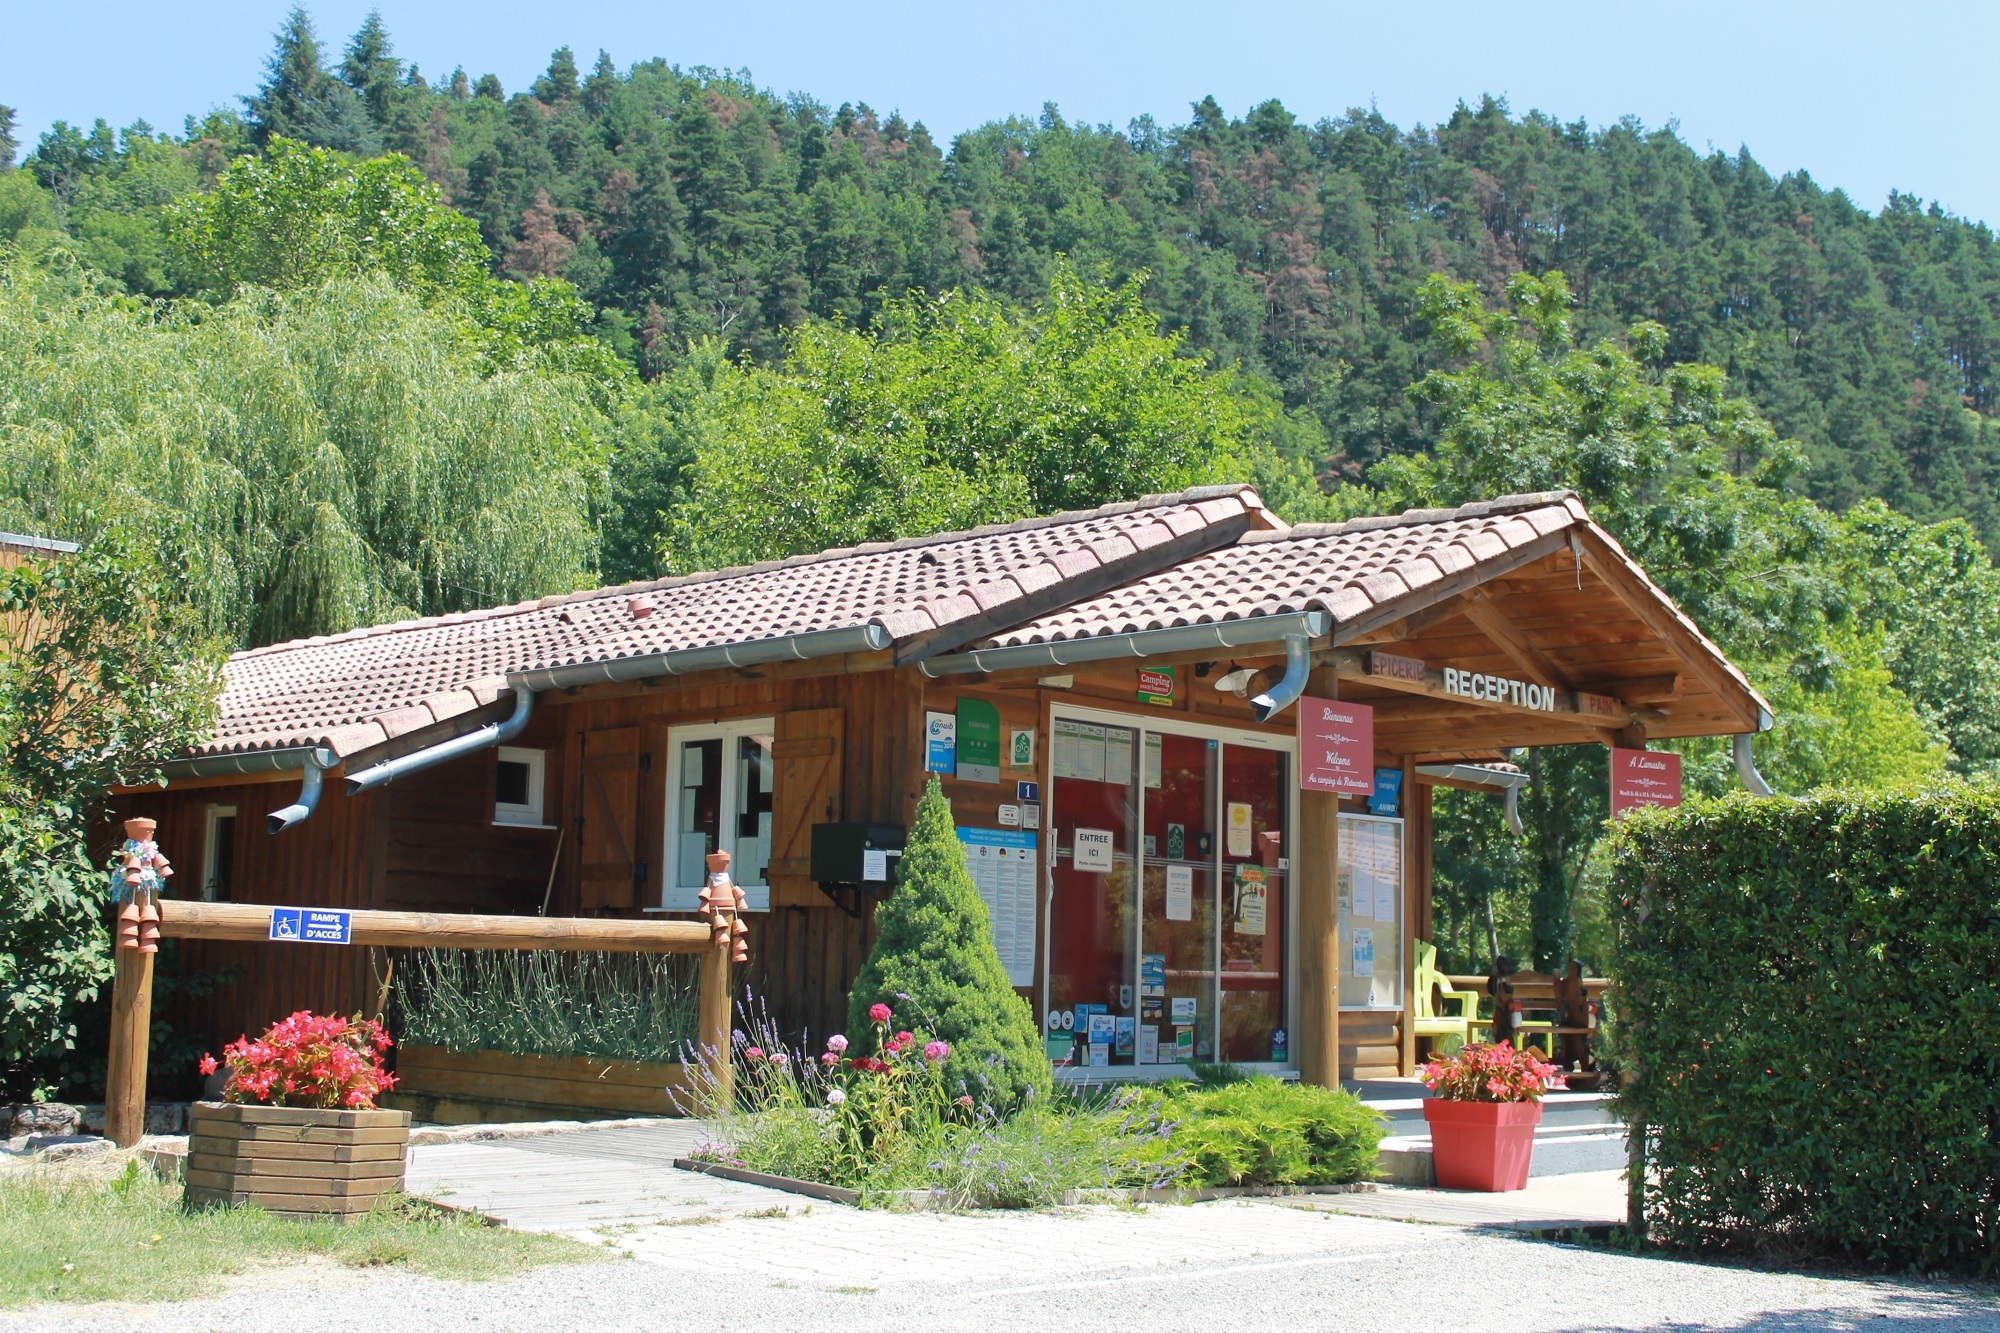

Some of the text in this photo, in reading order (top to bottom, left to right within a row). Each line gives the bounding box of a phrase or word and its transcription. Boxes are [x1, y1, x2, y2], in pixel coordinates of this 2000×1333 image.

[1373, 655, 1425, 681] EPICERIE
[1141, 673, 1170, 687] Camping
[1444, 668, 1555, 711] RECEPTION
[1590, 696, 1613, 716] PAIN
[1323, 707, 1354, 723] Bienvenue
[935, 722, 954, 730] anwb
[1325, 750, 1351, 766] Welcome
[1629, 757, 1666, 770] A Lamastre
[1308, 773, 1369, 788] Au camping de Retourtour
[1378, 782, 1396, 791] camping
[1025, 784, 1031, 798] 1
[1377, 803, 1397, 812] ANWB
[1080, 833, 1109, 843] ENTREE
[1088, 849, 1099, 857] ICI
[311, 913, 341, 923] RAMPE
